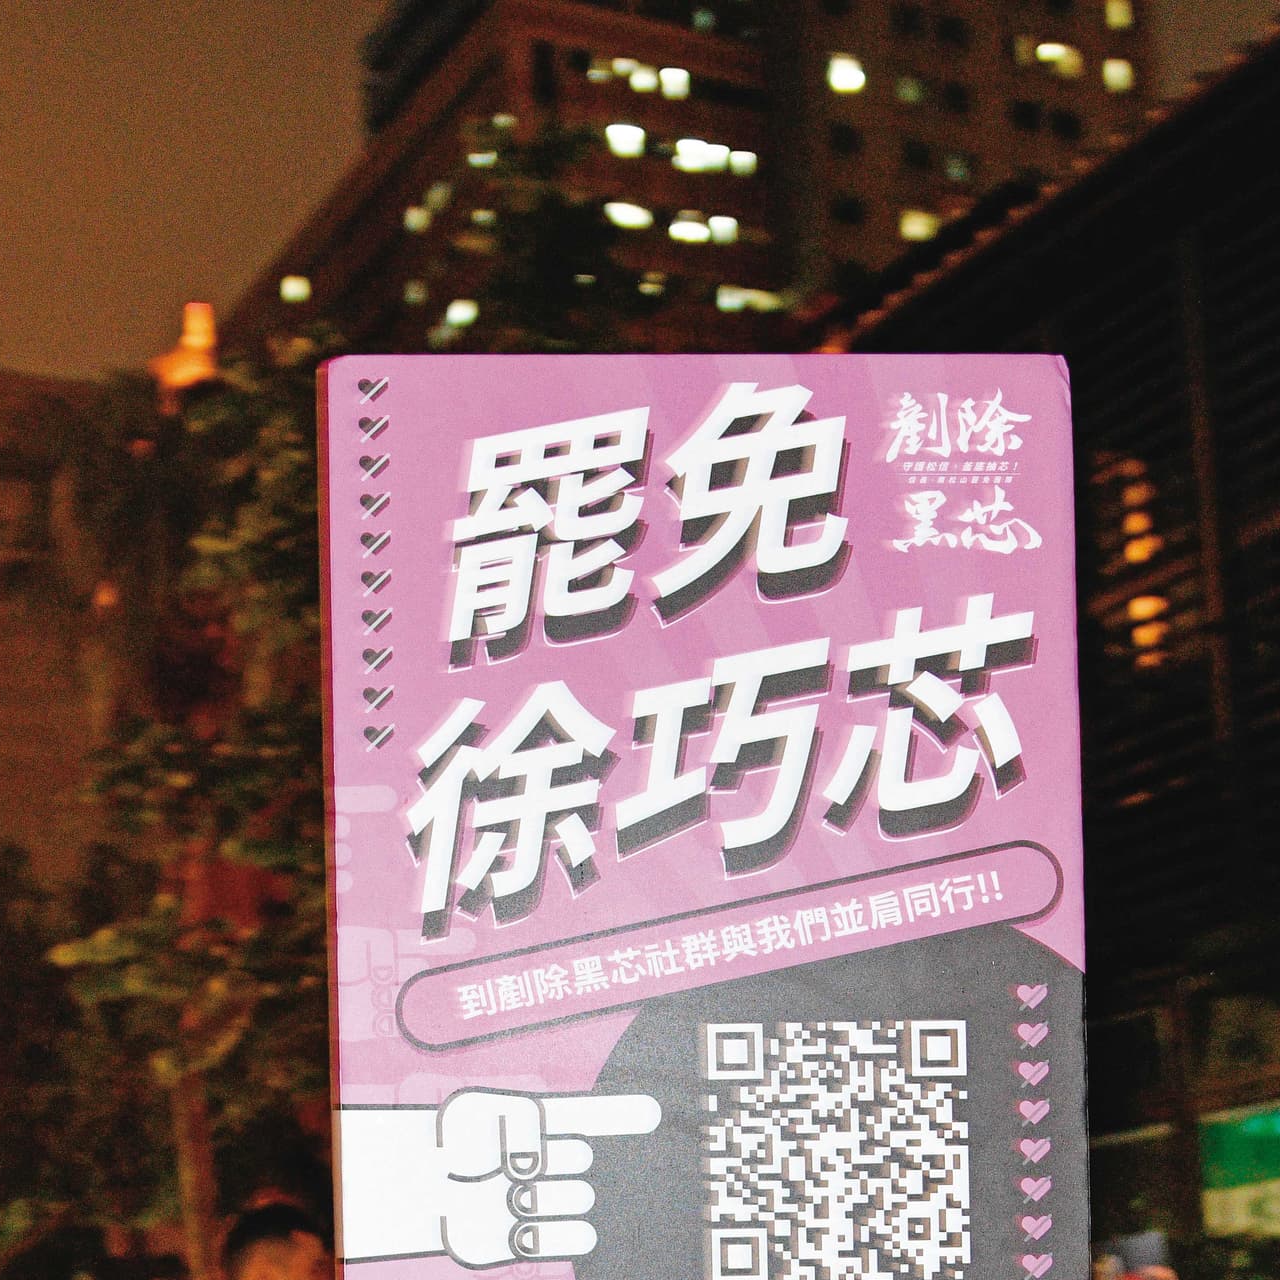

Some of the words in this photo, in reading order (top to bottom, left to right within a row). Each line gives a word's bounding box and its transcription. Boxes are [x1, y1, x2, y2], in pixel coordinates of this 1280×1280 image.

[447, 382, 851, 660] 罷免
[407, 593, 1035, 925] 徐巧芯
